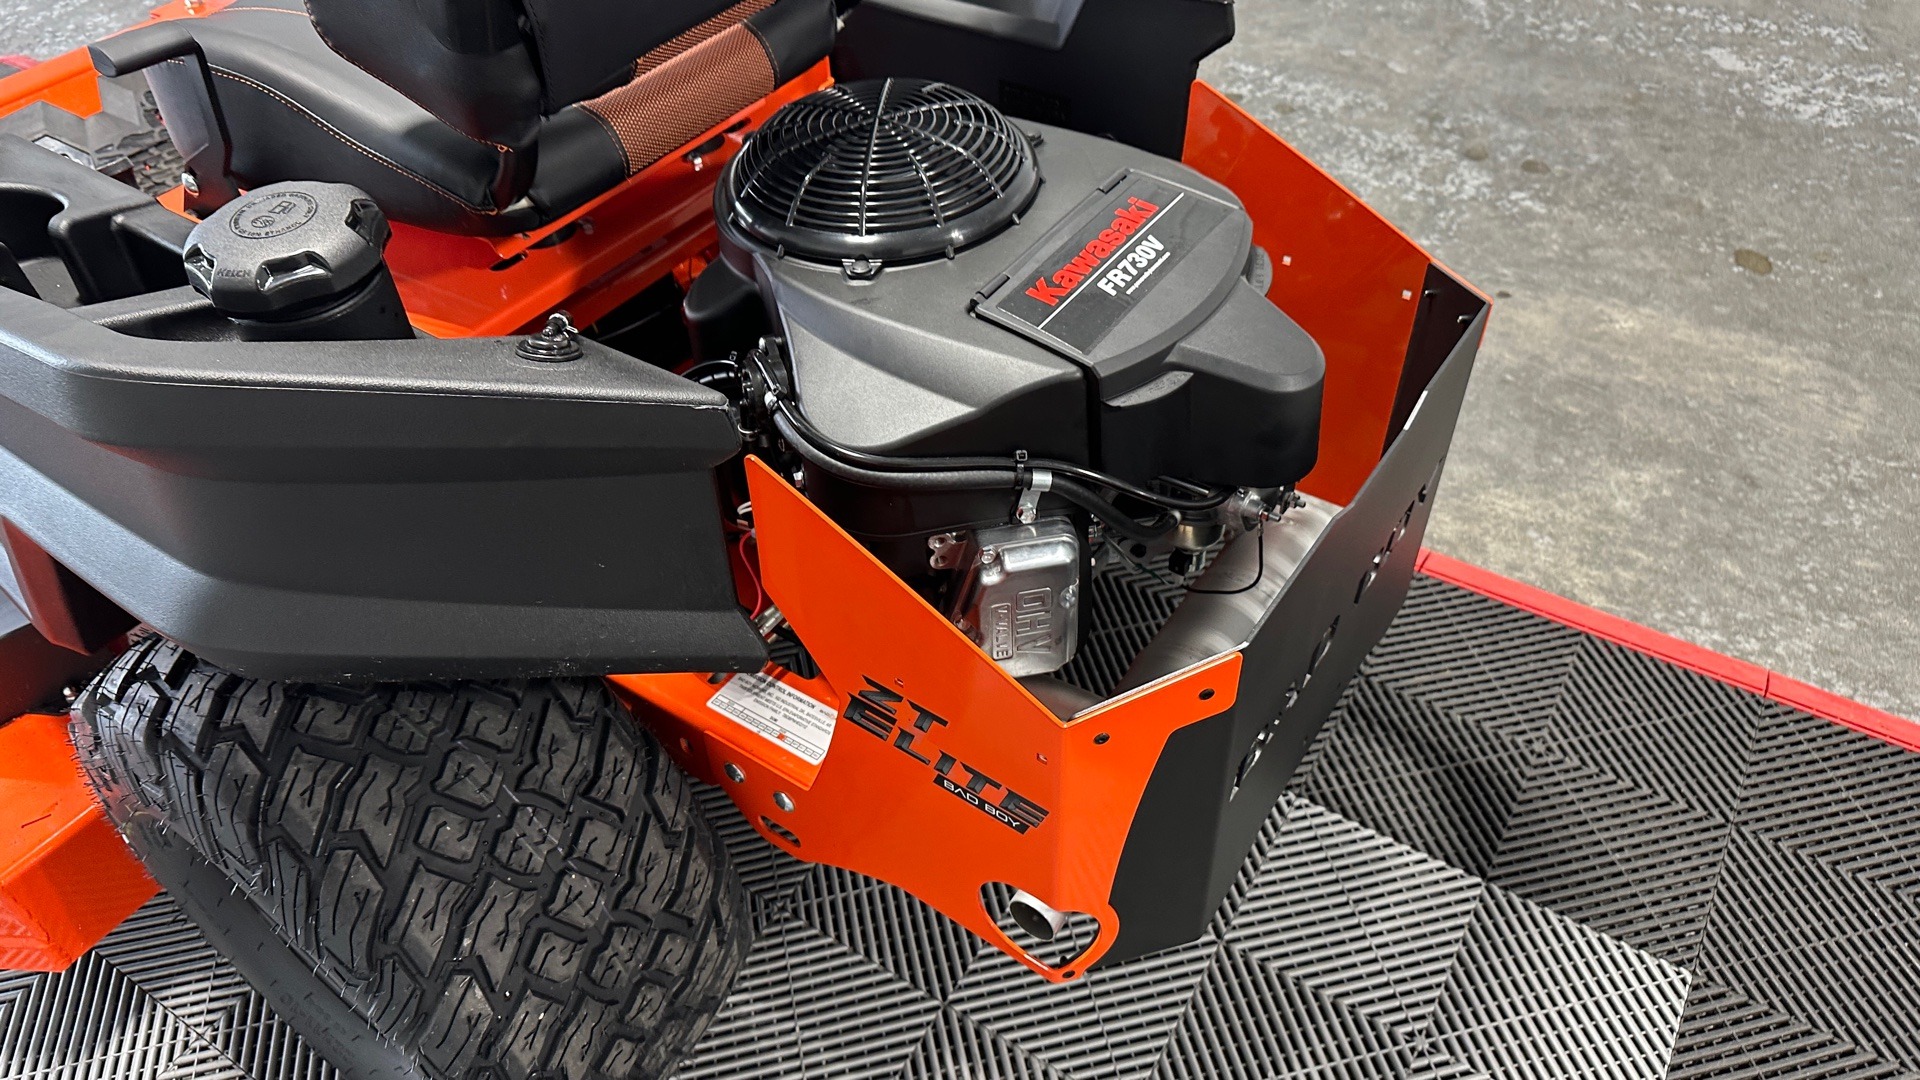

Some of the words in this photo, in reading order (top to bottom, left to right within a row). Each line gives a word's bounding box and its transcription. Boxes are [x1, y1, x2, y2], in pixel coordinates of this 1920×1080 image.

[1025, 196, 1160, 307] Kawasaki
[1097, 234, 1165, 297] FR730V
[1015, 587, 1052, 653] OHV
[858, 674, 949, 733] ZT
[843, 692, 1050, 828] ELITE
[943, 779, 979, 805] BAD
[984, 803, 1020, 828] BOY
